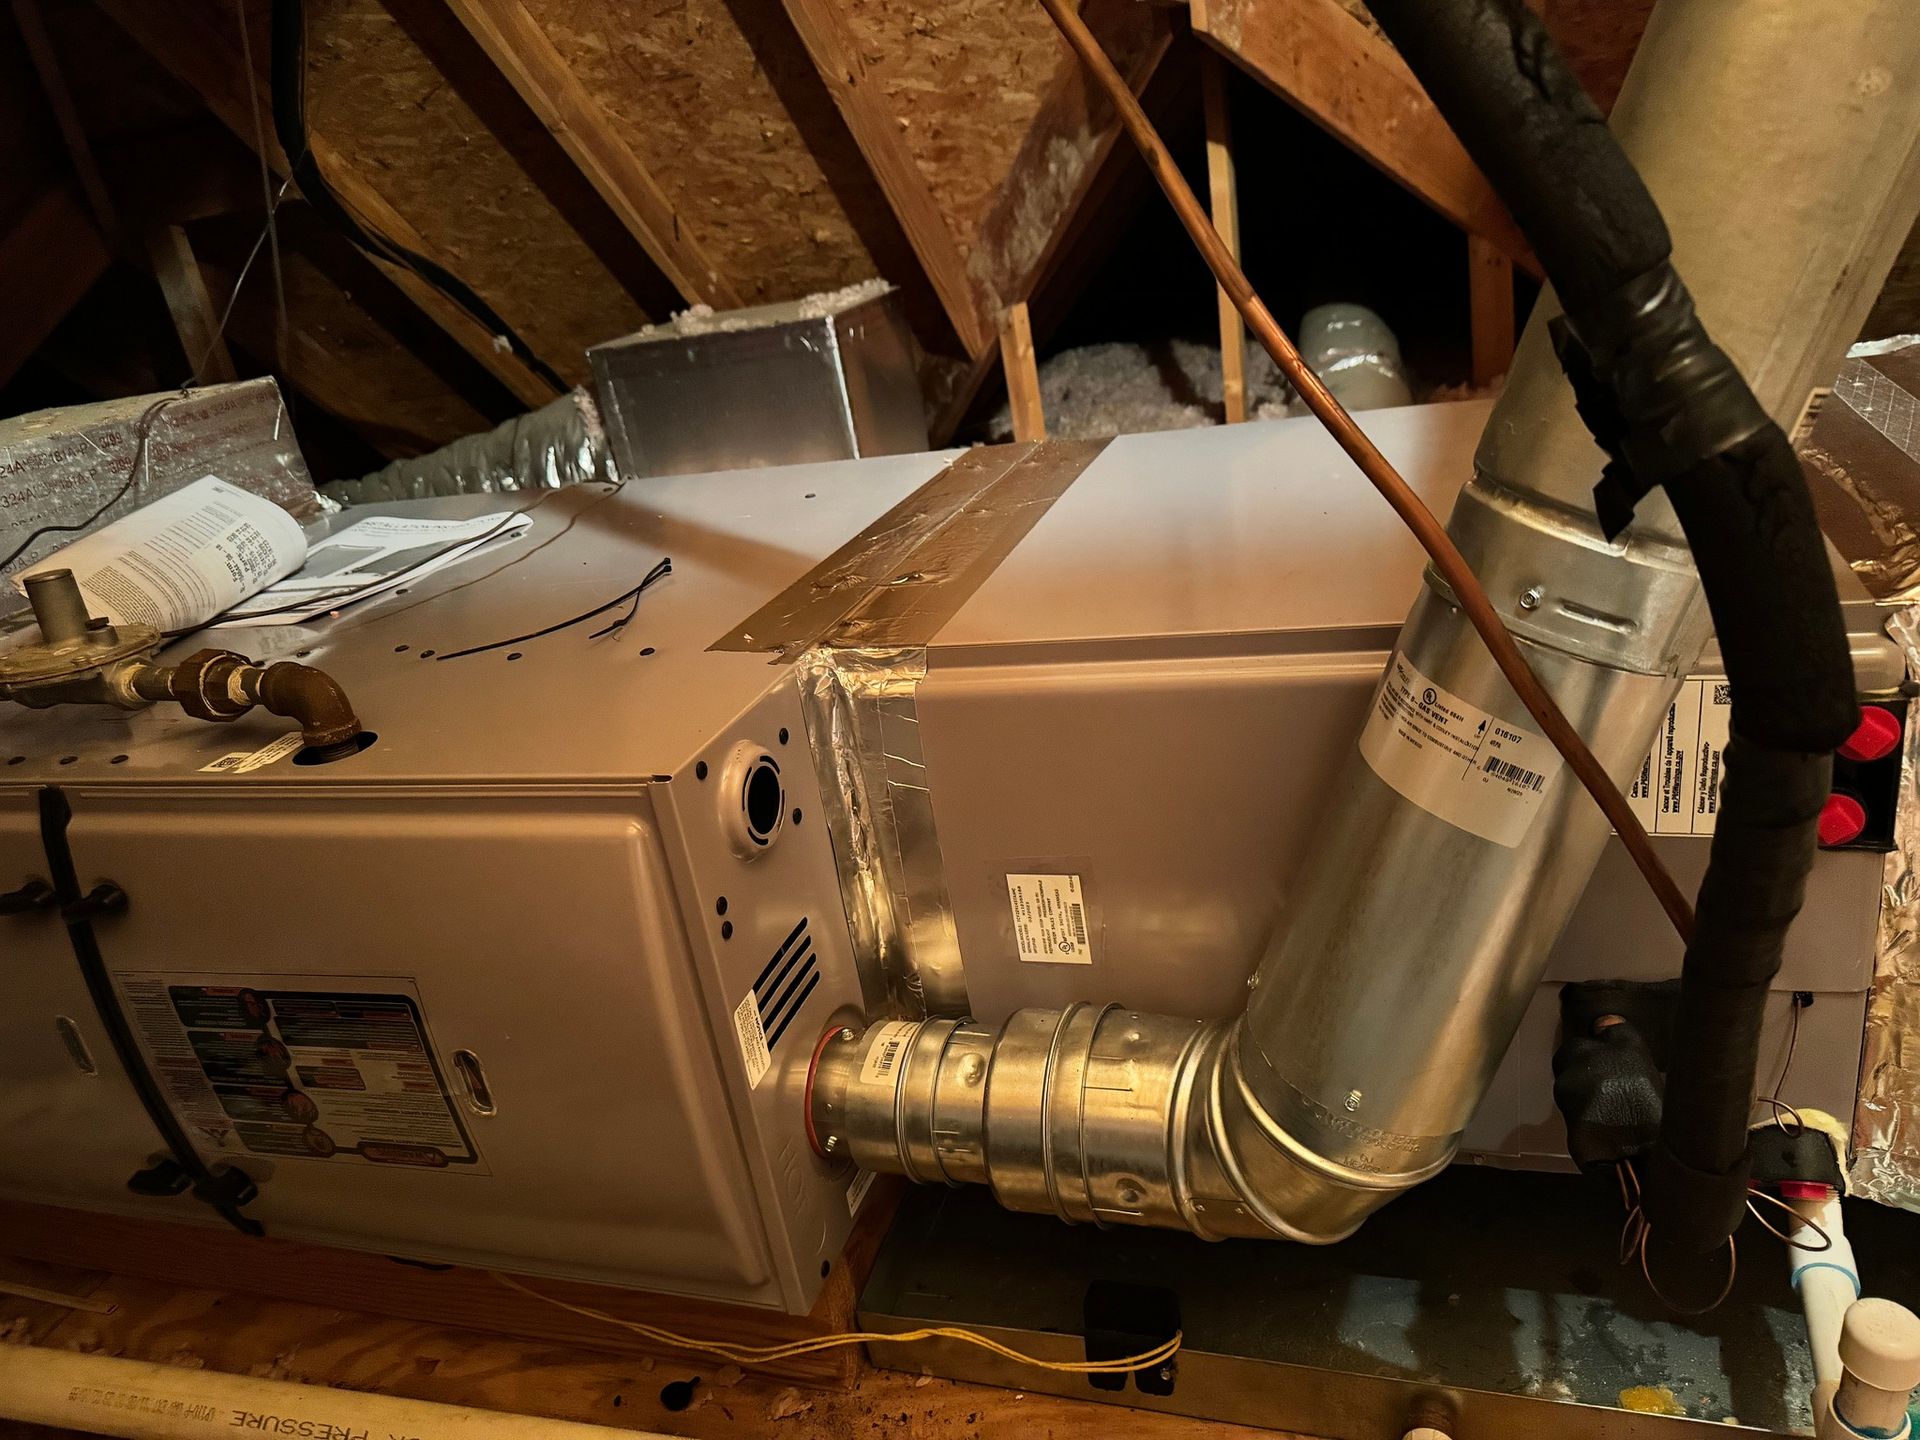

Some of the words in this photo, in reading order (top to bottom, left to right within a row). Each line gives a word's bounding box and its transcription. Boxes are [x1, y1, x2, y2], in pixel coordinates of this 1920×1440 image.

[1, 488, 36, 508] 324A
[1431, 710, 1448, 725] VENT
[1495, 728, 1522, 743] 016107
